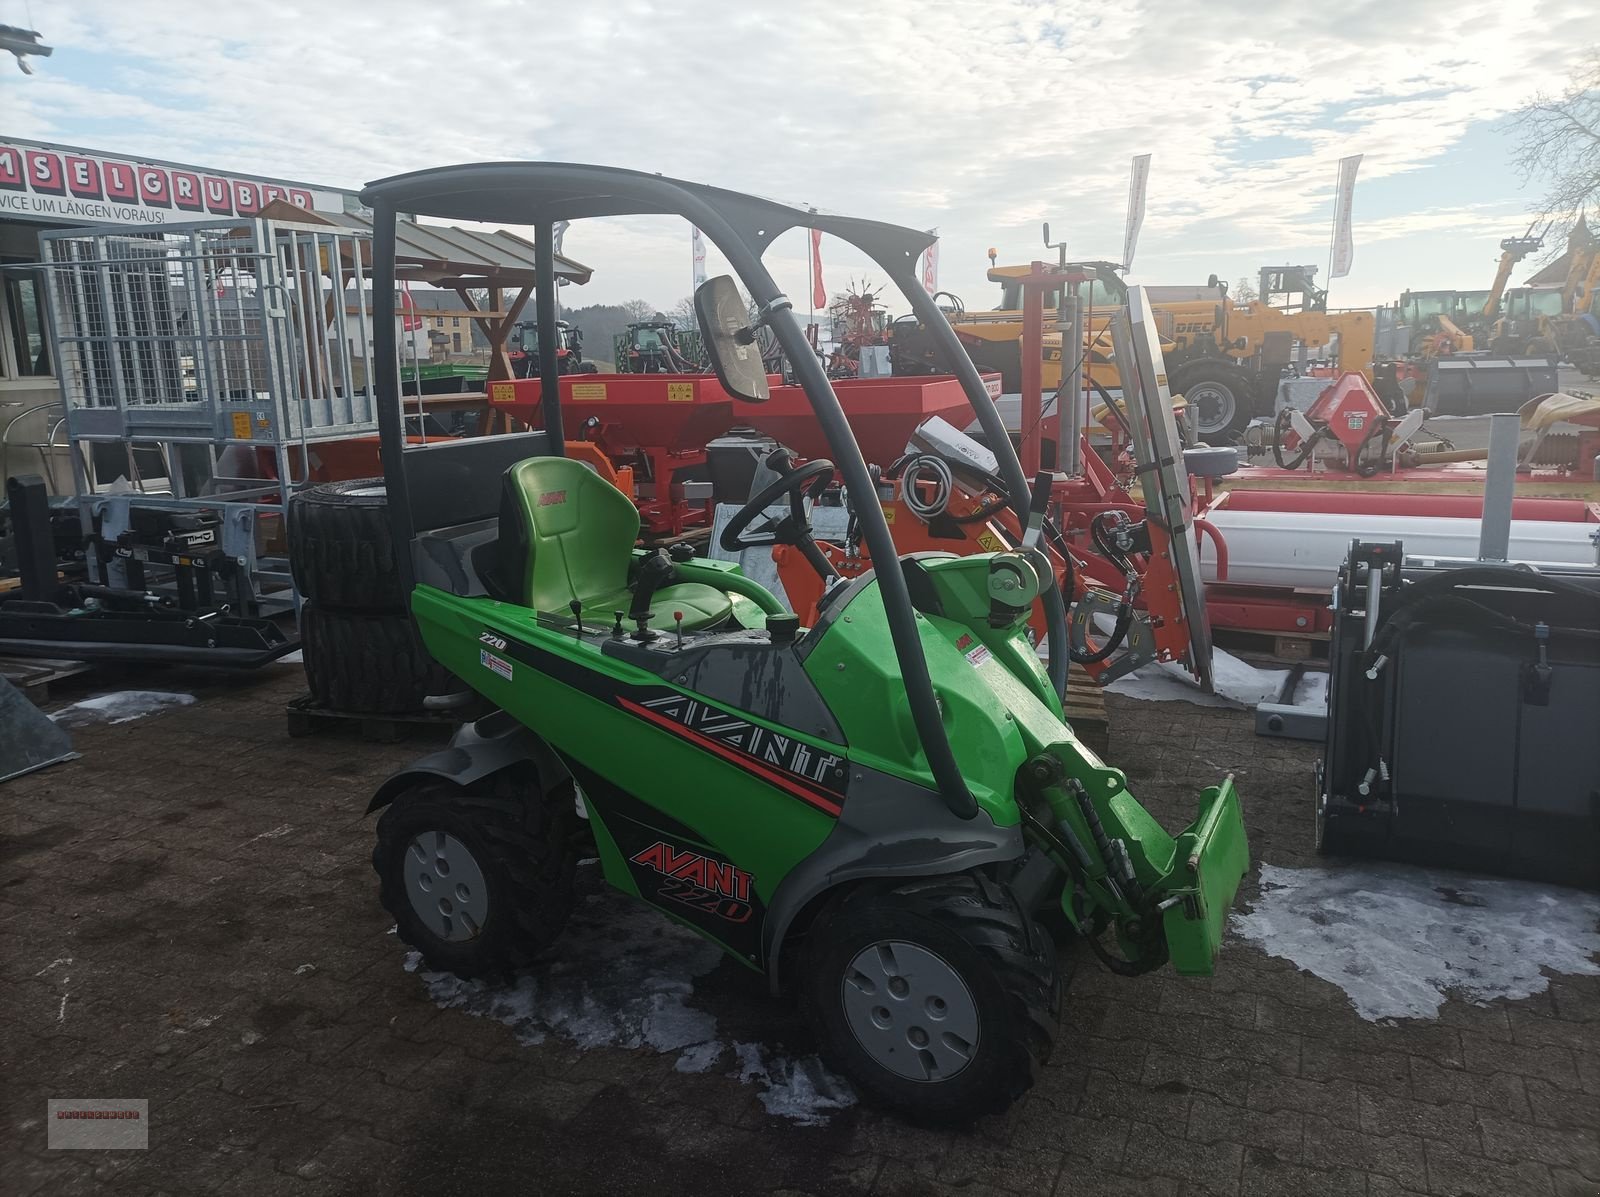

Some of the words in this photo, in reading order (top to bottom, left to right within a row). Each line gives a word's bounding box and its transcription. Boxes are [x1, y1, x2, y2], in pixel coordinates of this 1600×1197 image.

[32, 197, 56, 213] UM
[58, 199, 112, 218] LÄNGEN
[110, 207, 165, 224] VORAUS!
[479, 631, 507, 650] 220
[640, 694, 844, 783] AVANT
[629, 841, 753, 902] AVANT
[657, 879, 753, 923] 220
